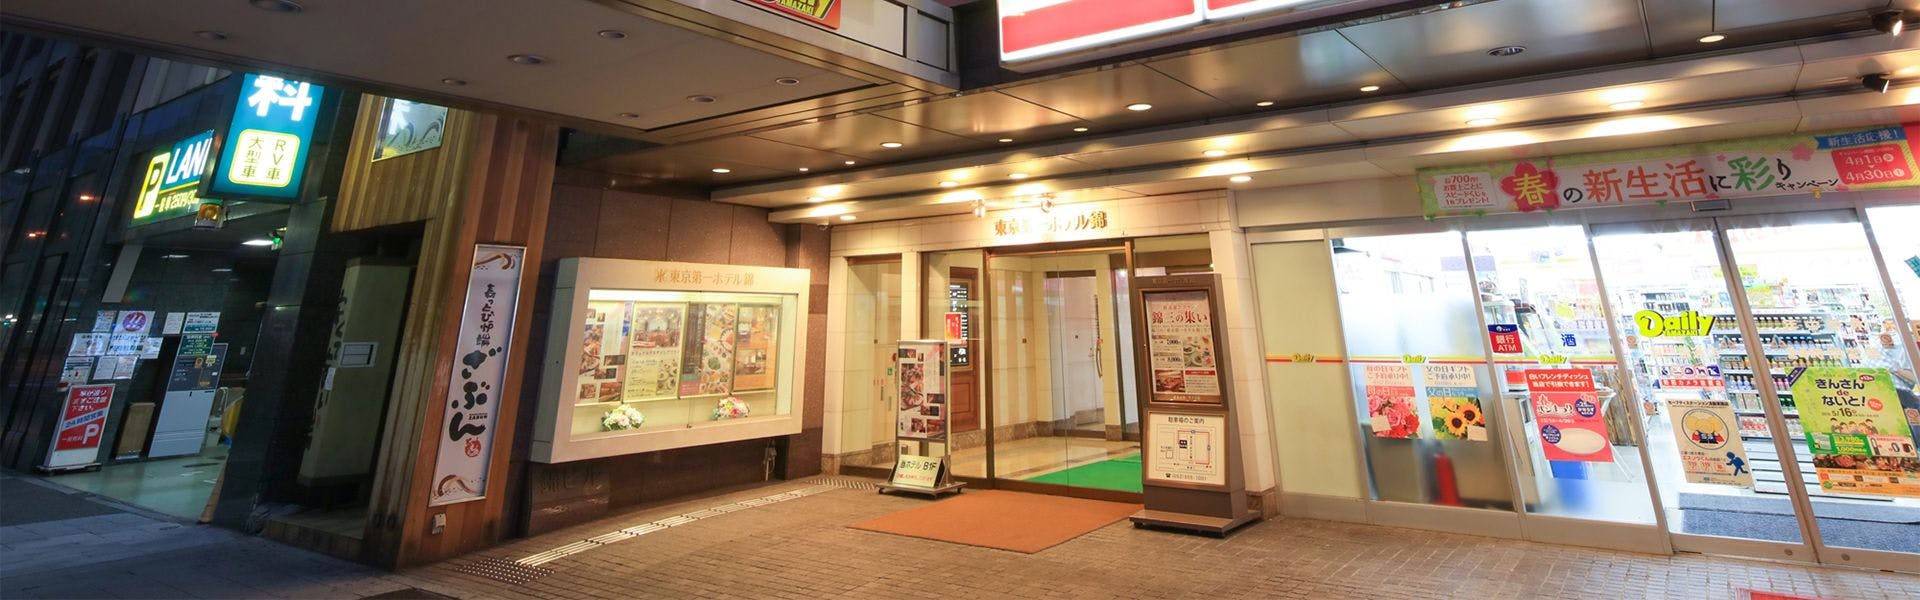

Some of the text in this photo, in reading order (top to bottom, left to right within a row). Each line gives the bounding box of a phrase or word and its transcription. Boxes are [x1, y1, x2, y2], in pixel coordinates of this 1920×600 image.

[241, 136, 264, 178] 大型車
[133, 151, 171, 219] P
[1775, 178, 1839, 191] キャンペーン
[670, 269, 754, 288] 東京第一ホテル錦
[1152, 310, 1208, 324] 錦三の集い
[1634, 310, 1717, 337] Daily
[1495, 335, 1515, 344] 銀行
[1561, 333, 1577, 347] 酒
[1403, 354, 1427, 364] Daily
[1540, 354, 1567, 365] Daily
[1426, 365, 1470, 373] 父の日ギフト
[1815, 379, 1865, 389] きんさん
[449, 346, 503, 442] ざぶん
[1821, 396, 1866, 407] ないと!
[82, 424, 100, 445] P
